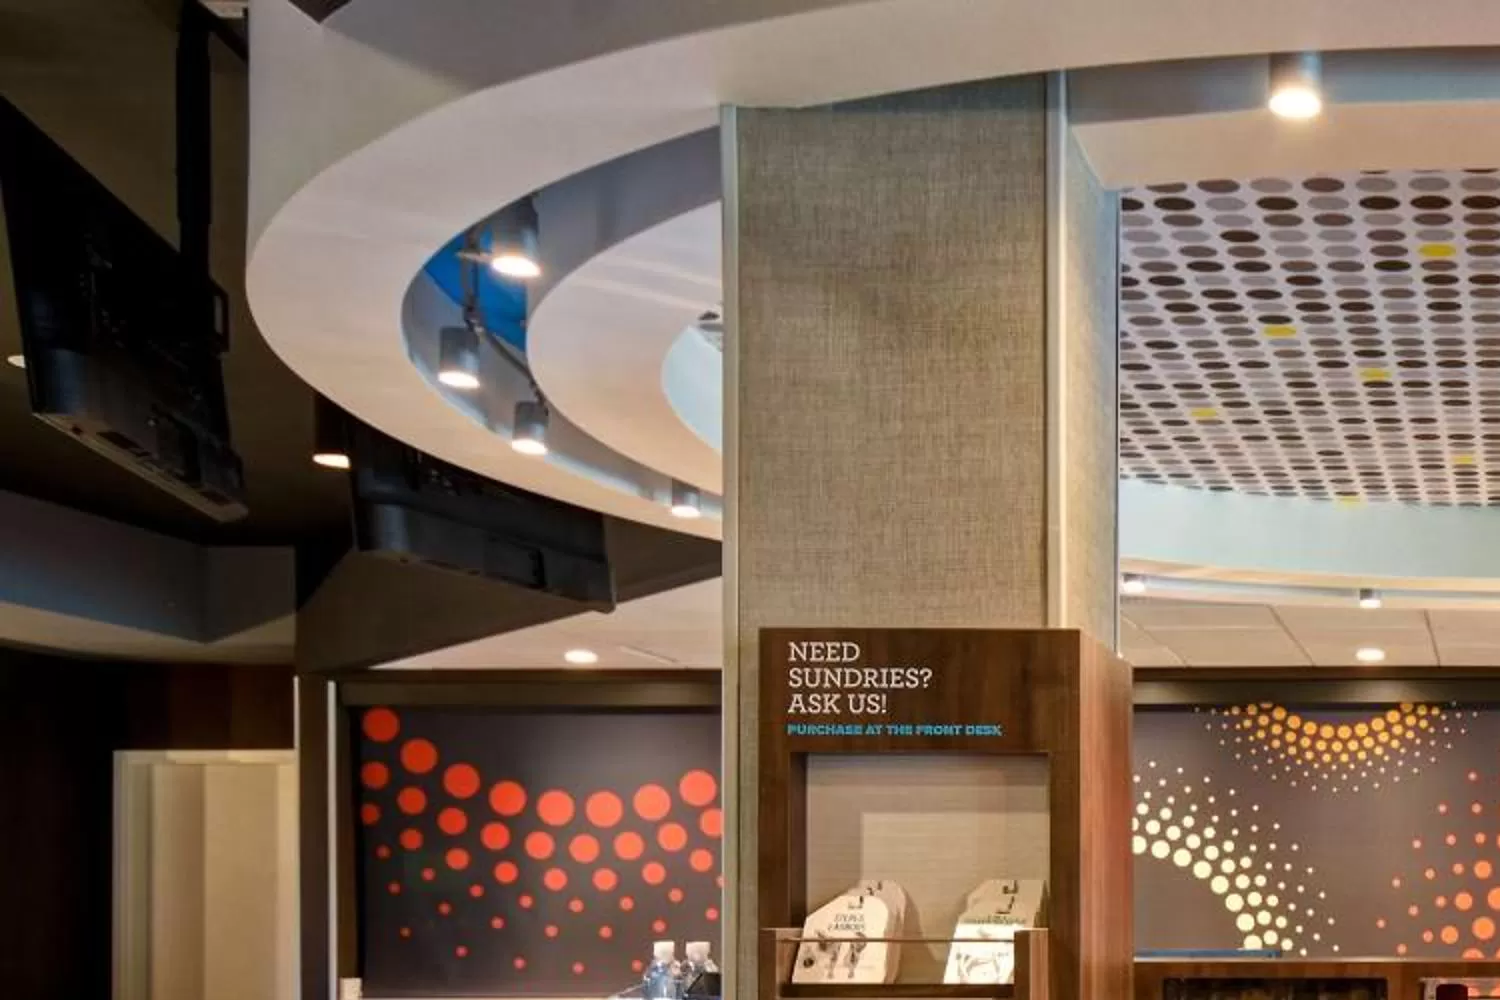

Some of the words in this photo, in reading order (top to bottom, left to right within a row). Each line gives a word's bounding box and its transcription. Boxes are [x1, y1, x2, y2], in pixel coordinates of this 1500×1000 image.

[788, 641, 861, 662] NEED
[788, 667, 933, 688] SUNDRIES?
[787, 693, 841, 714] ASK
[848, 693, 888, 714] US!
[787, 724, 863, 736] PURCHASE
[865, 724, 883, 736] AT
[886, 724, 913, 736] THE
[917, 724, 962, 736] FRONT
[965, 724, 1003, 736] DESK
